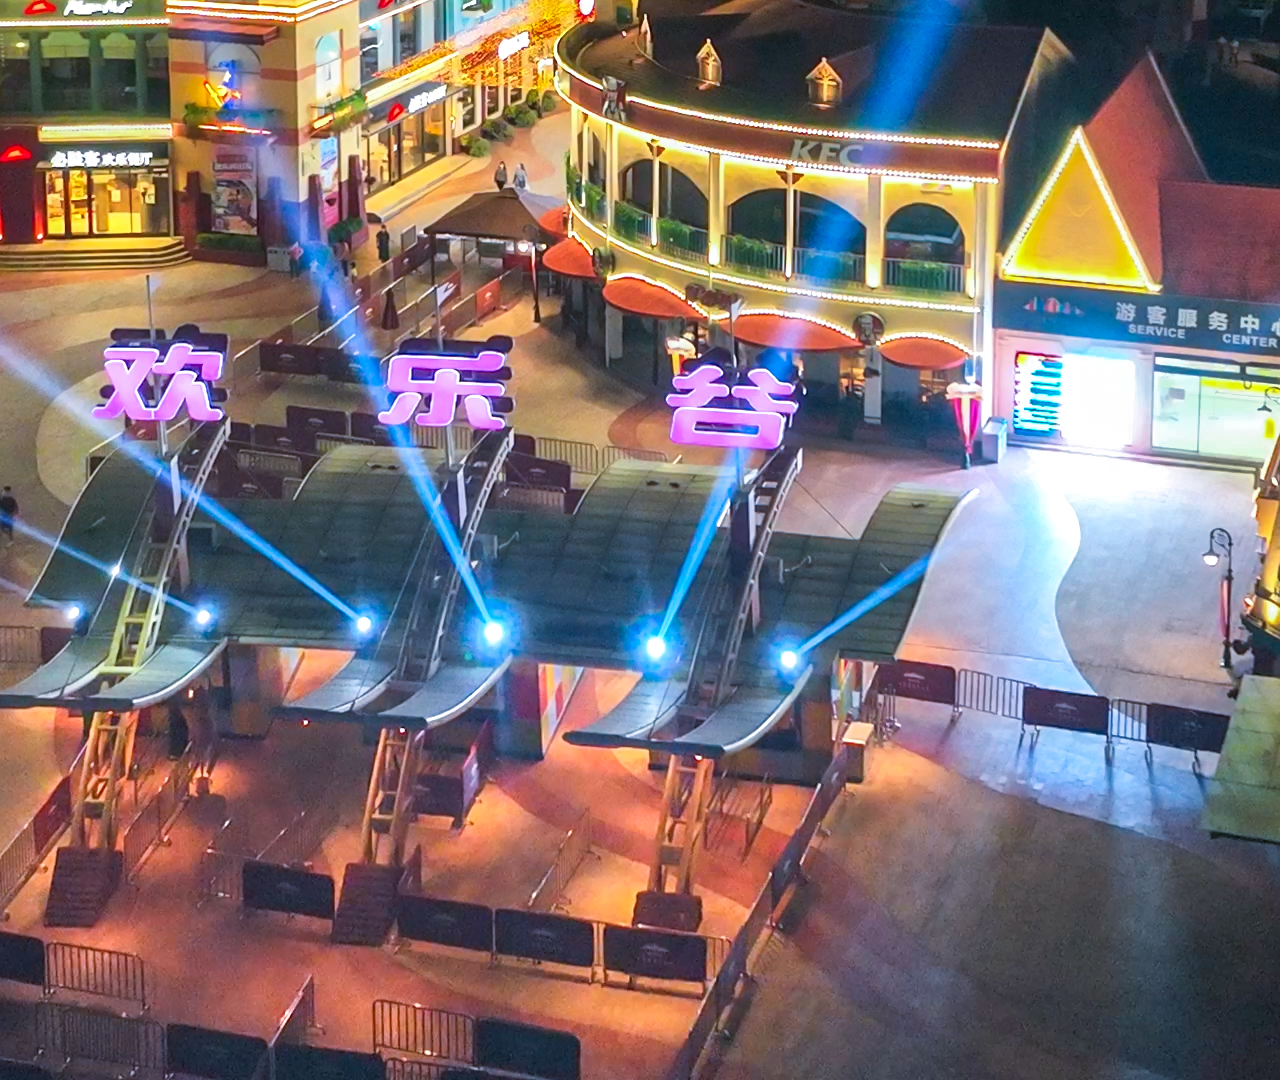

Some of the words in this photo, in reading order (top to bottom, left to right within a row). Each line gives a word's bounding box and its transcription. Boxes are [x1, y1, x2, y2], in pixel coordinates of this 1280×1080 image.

[790, 139, 865, 167] KFC
[1128, 323, 1186, 339] SERVICE
[1222, 333, 1278, 348] CENTER
[92, 342, 798, 449] 欢乐谷
